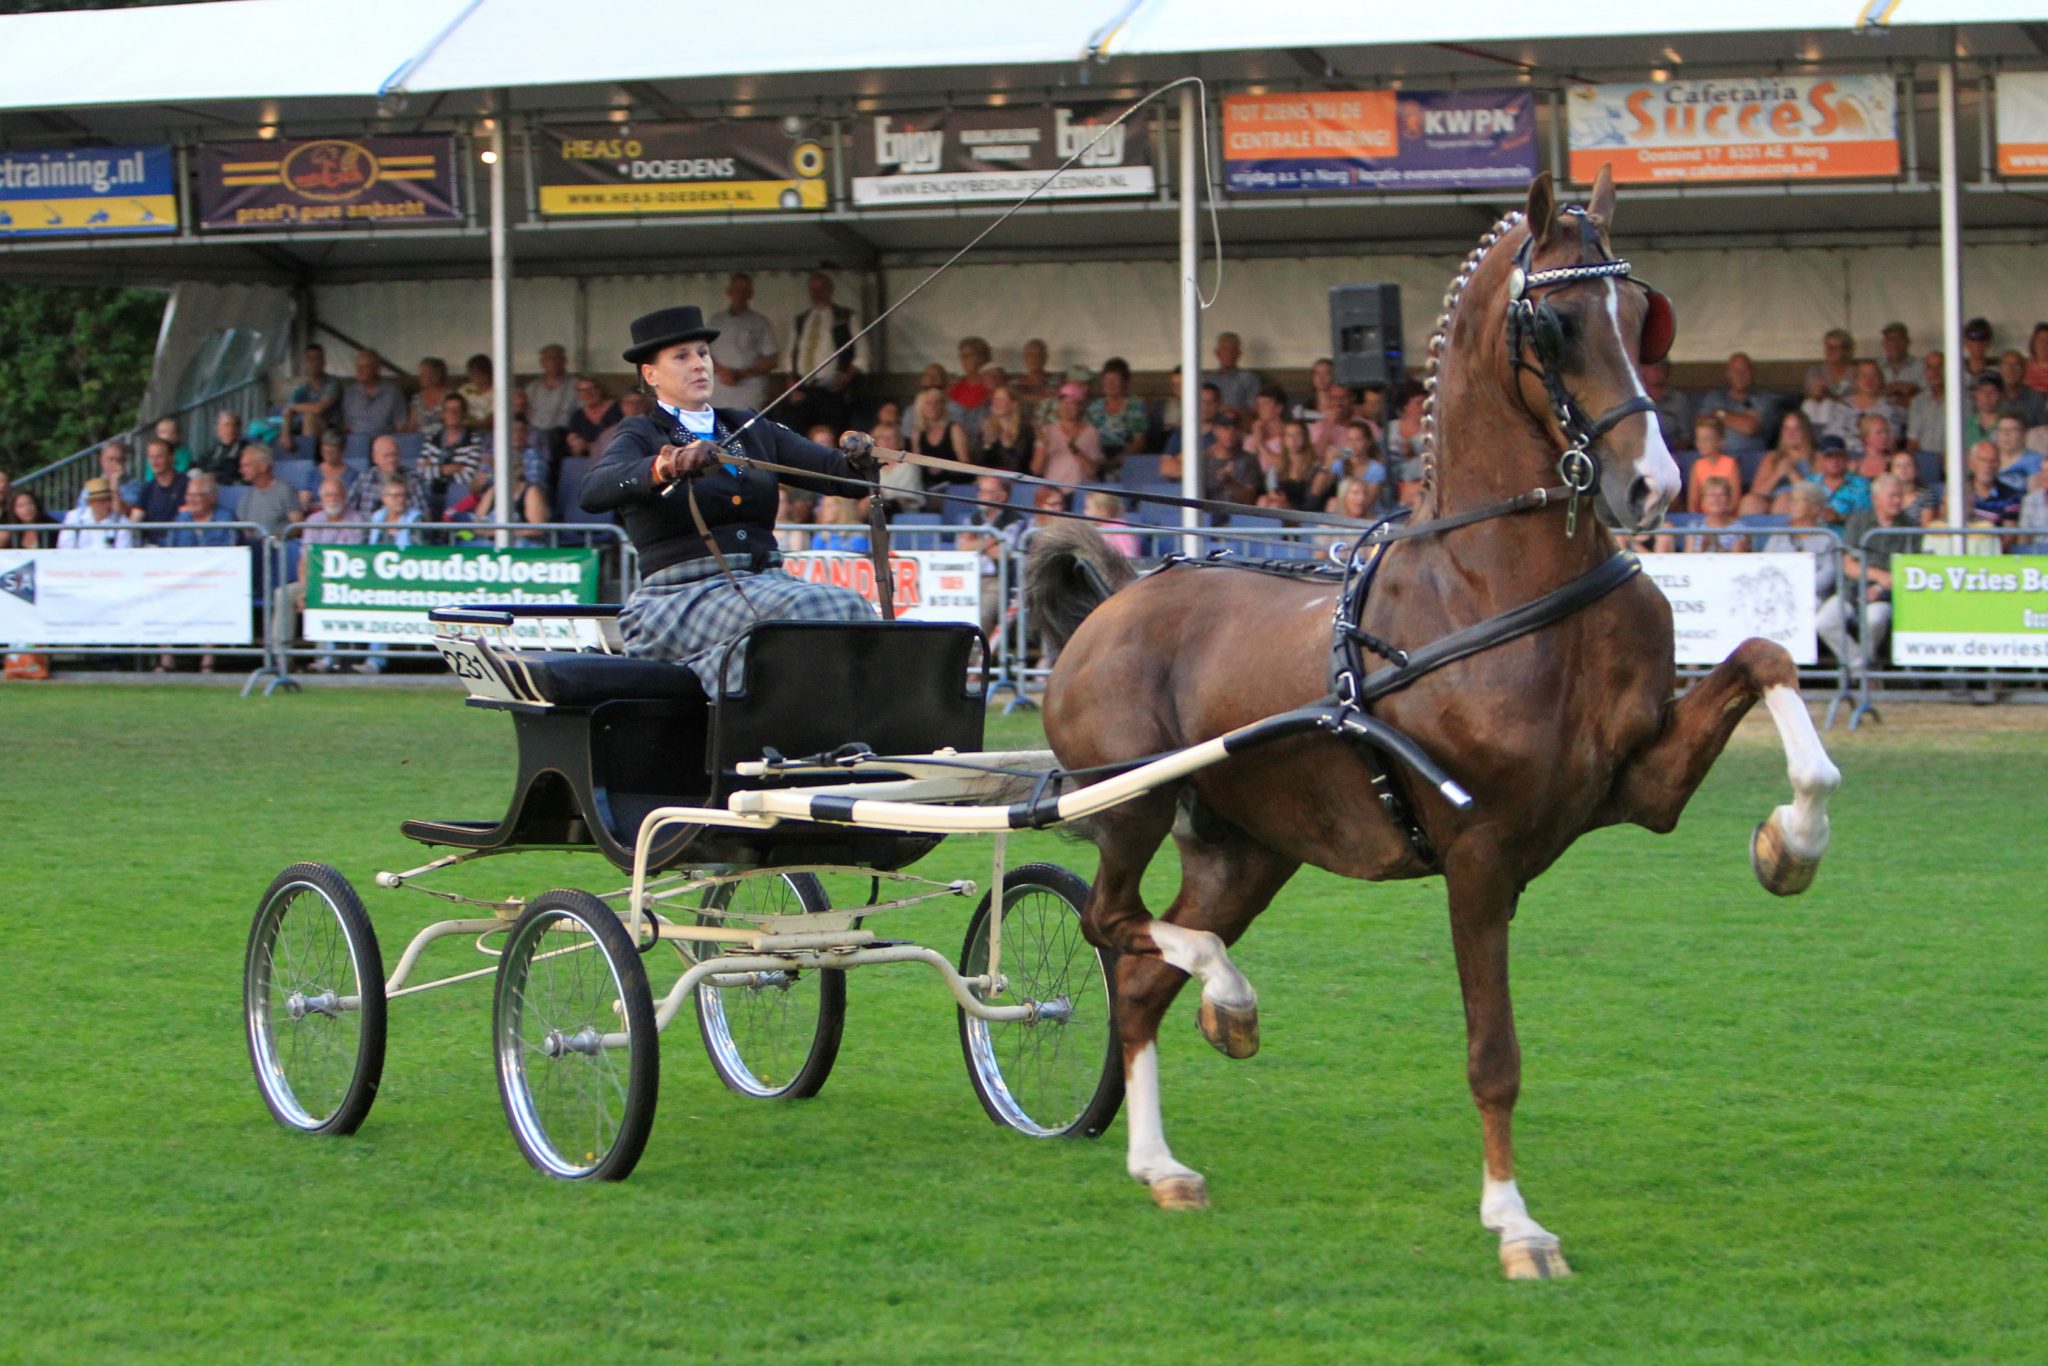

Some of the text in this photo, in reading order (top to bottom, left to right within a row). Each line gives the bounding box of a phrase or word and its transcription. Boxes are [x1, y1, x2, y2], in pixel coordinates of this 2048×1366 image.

[1664, 82, 1798, 104] Cafetaria
[1423, 109, 1516, 135] KWPN
[874, 115, 944, 173] Enjoy
[631, 158, 736, 180] DOEDENS
[320, 549, 583, 584] De Goudsbloem
[1904, 567, 1944, 591] De
[1945, 567, 2018, 592] Vries
[443, 650, 495, 682] 231
